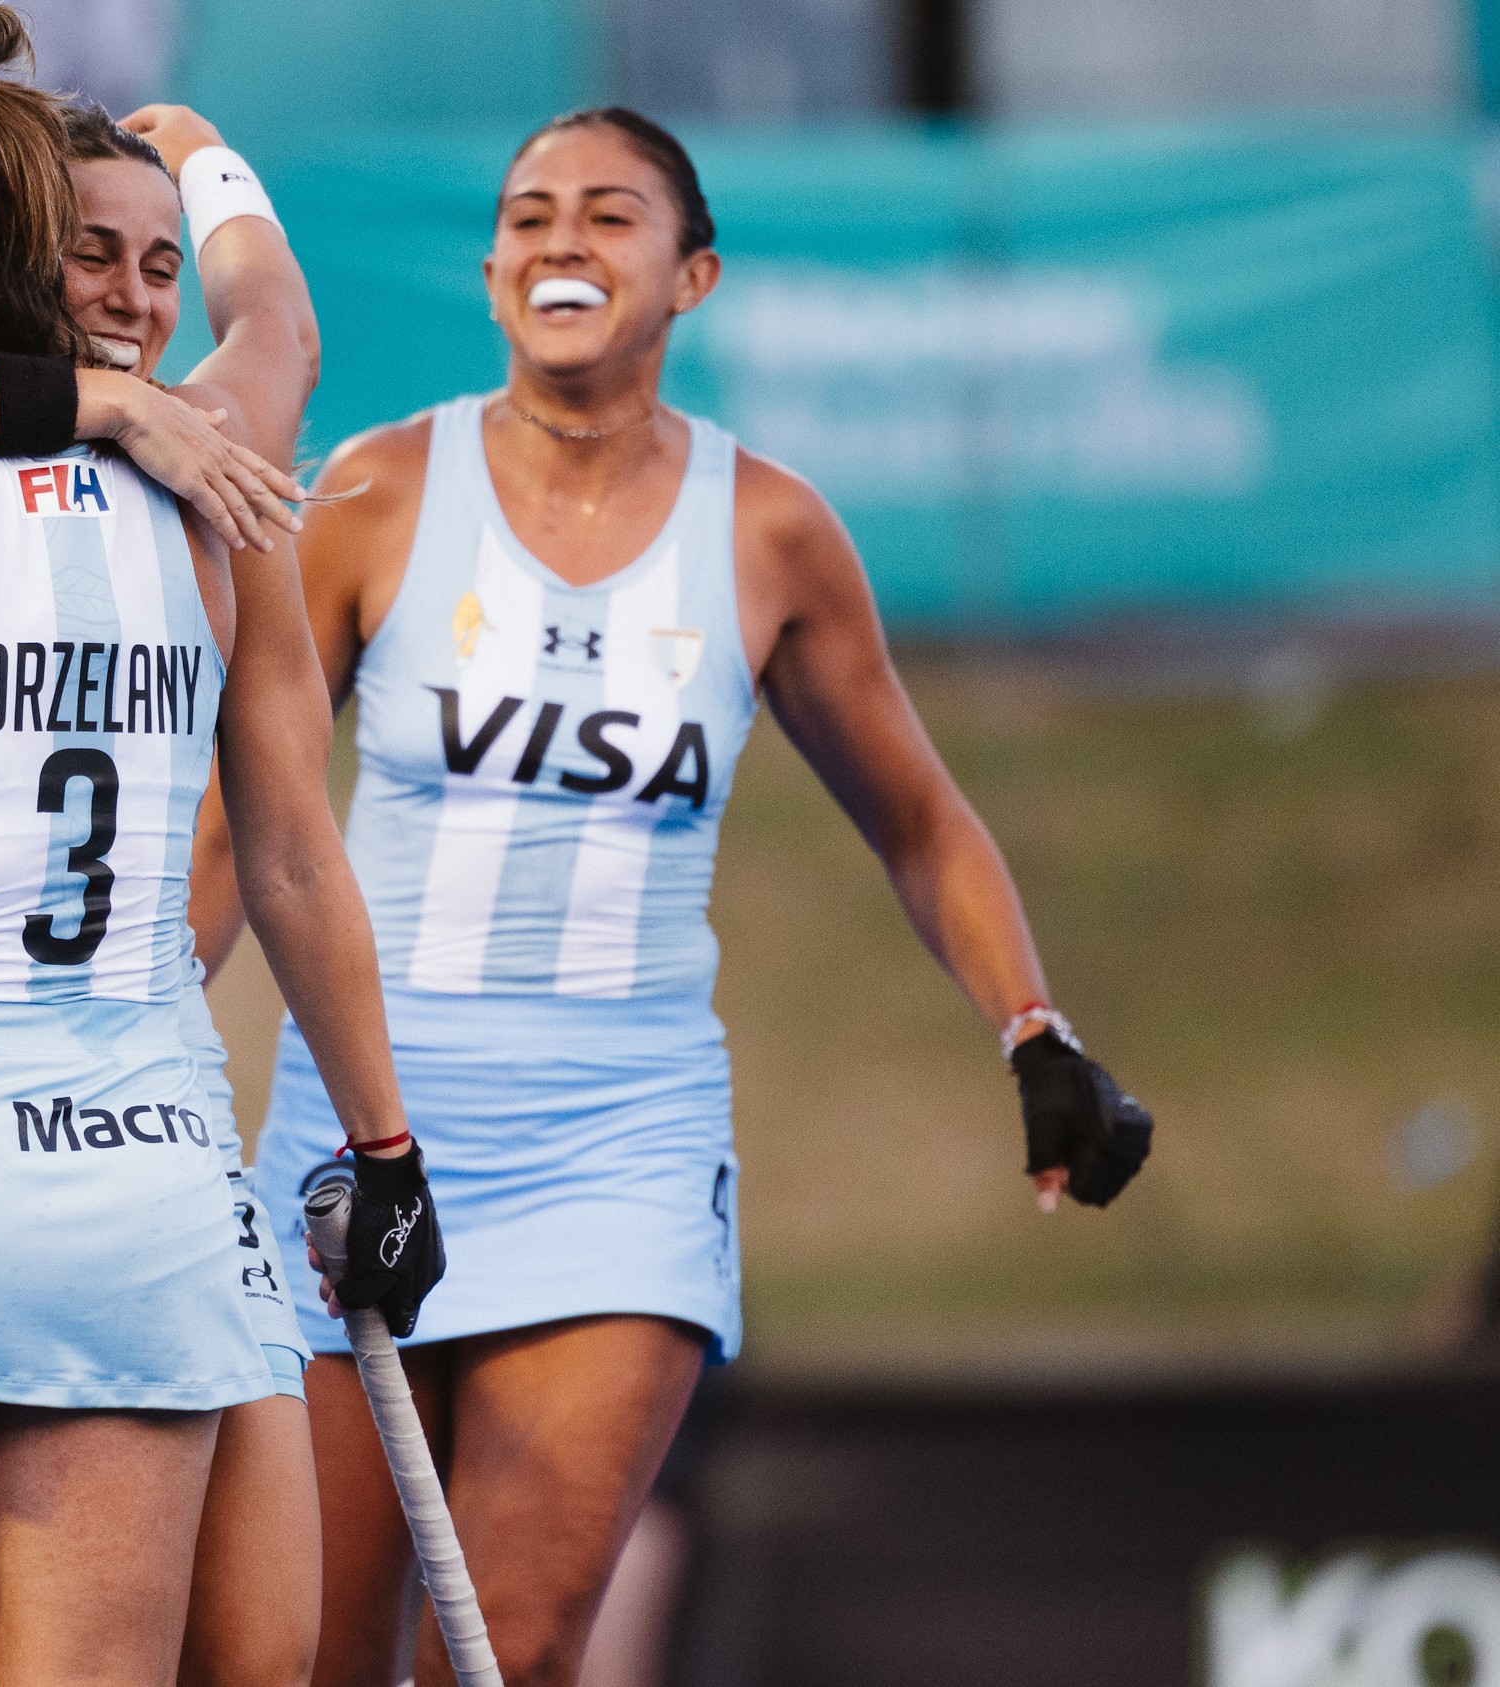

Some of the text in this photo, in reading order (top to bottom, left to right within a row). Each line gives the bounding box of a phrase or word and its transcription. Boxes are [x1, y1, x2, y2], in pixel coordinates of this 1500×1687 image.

[18, 465, 110, 513] FIH
[421, 682, 709, 810] VISA
[22, 747, 119, 966] 3
[13, 1096, 210, 1152] Macro
